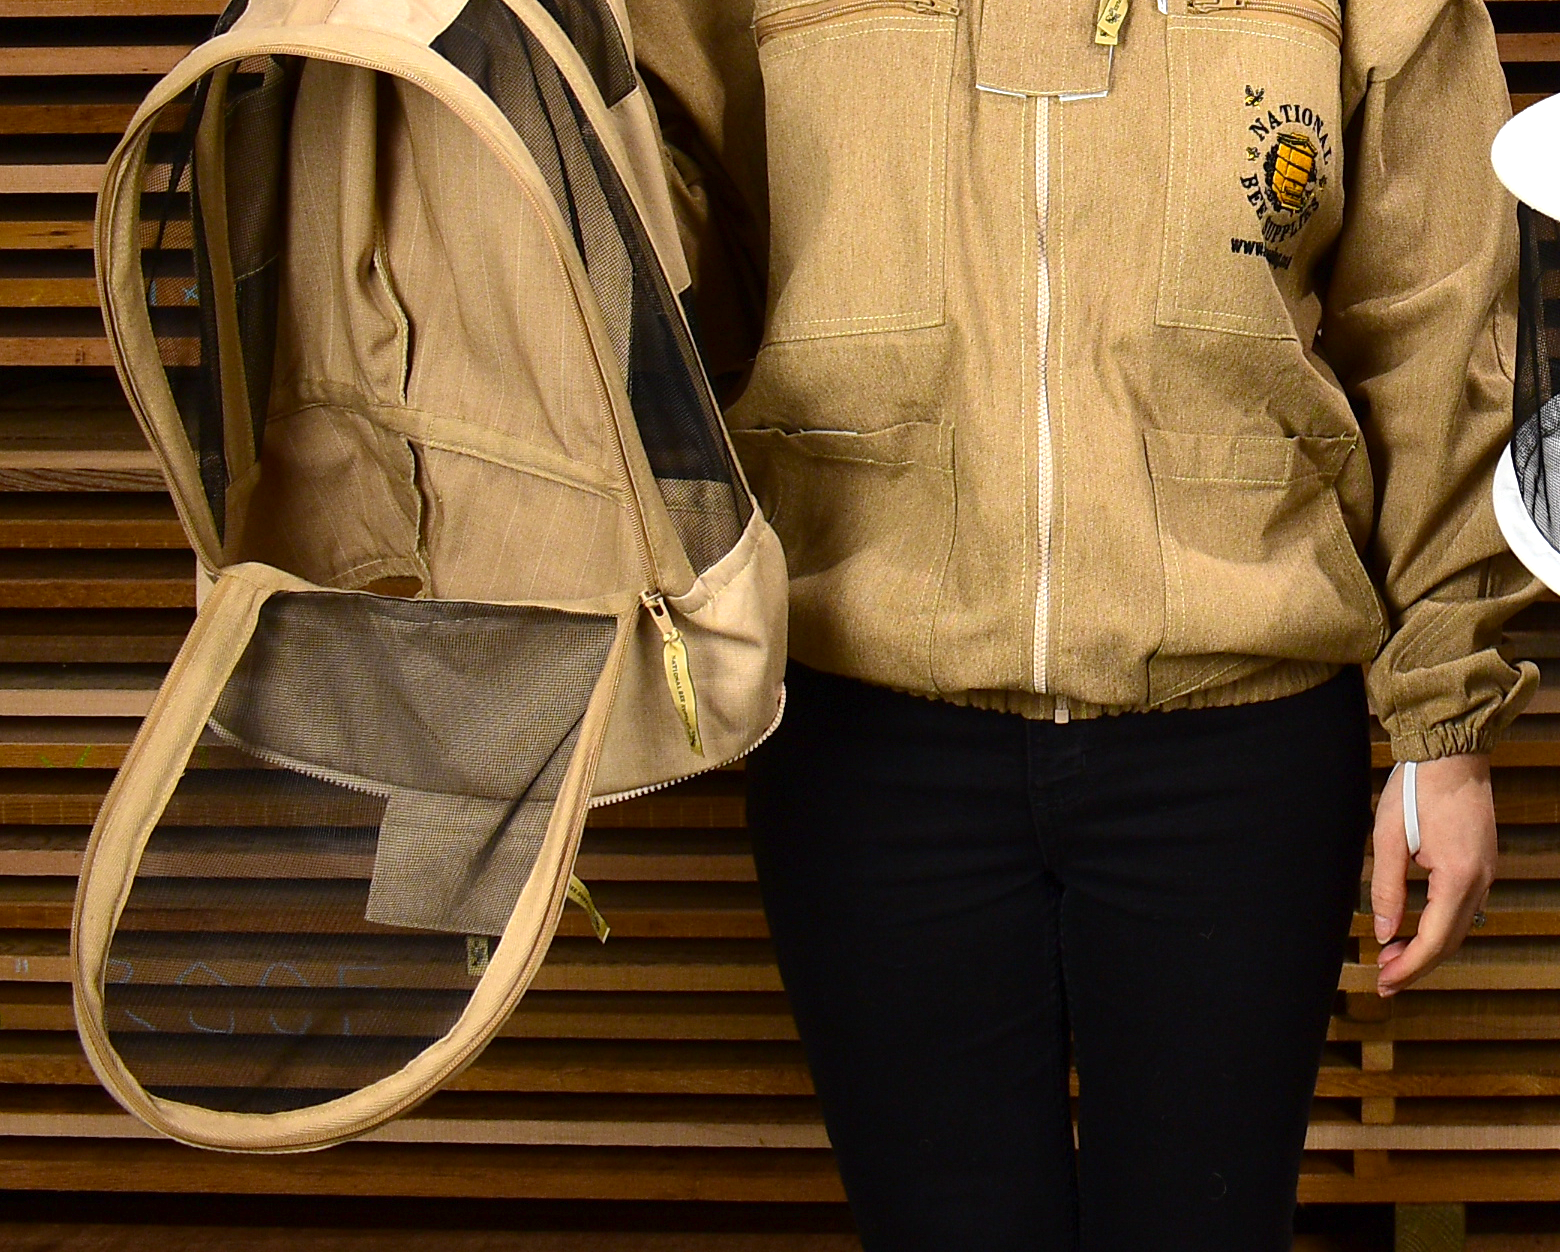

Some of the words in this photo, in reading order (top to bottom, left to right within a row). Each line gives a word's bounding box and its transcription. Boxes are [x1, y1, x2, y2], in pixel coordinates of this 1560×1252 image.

[1248, 104, 1333, 166] NATIONAL
[1239, 173, 1269, 221] BEE
[1262, 201, 1320, 243] SUPPLIES
